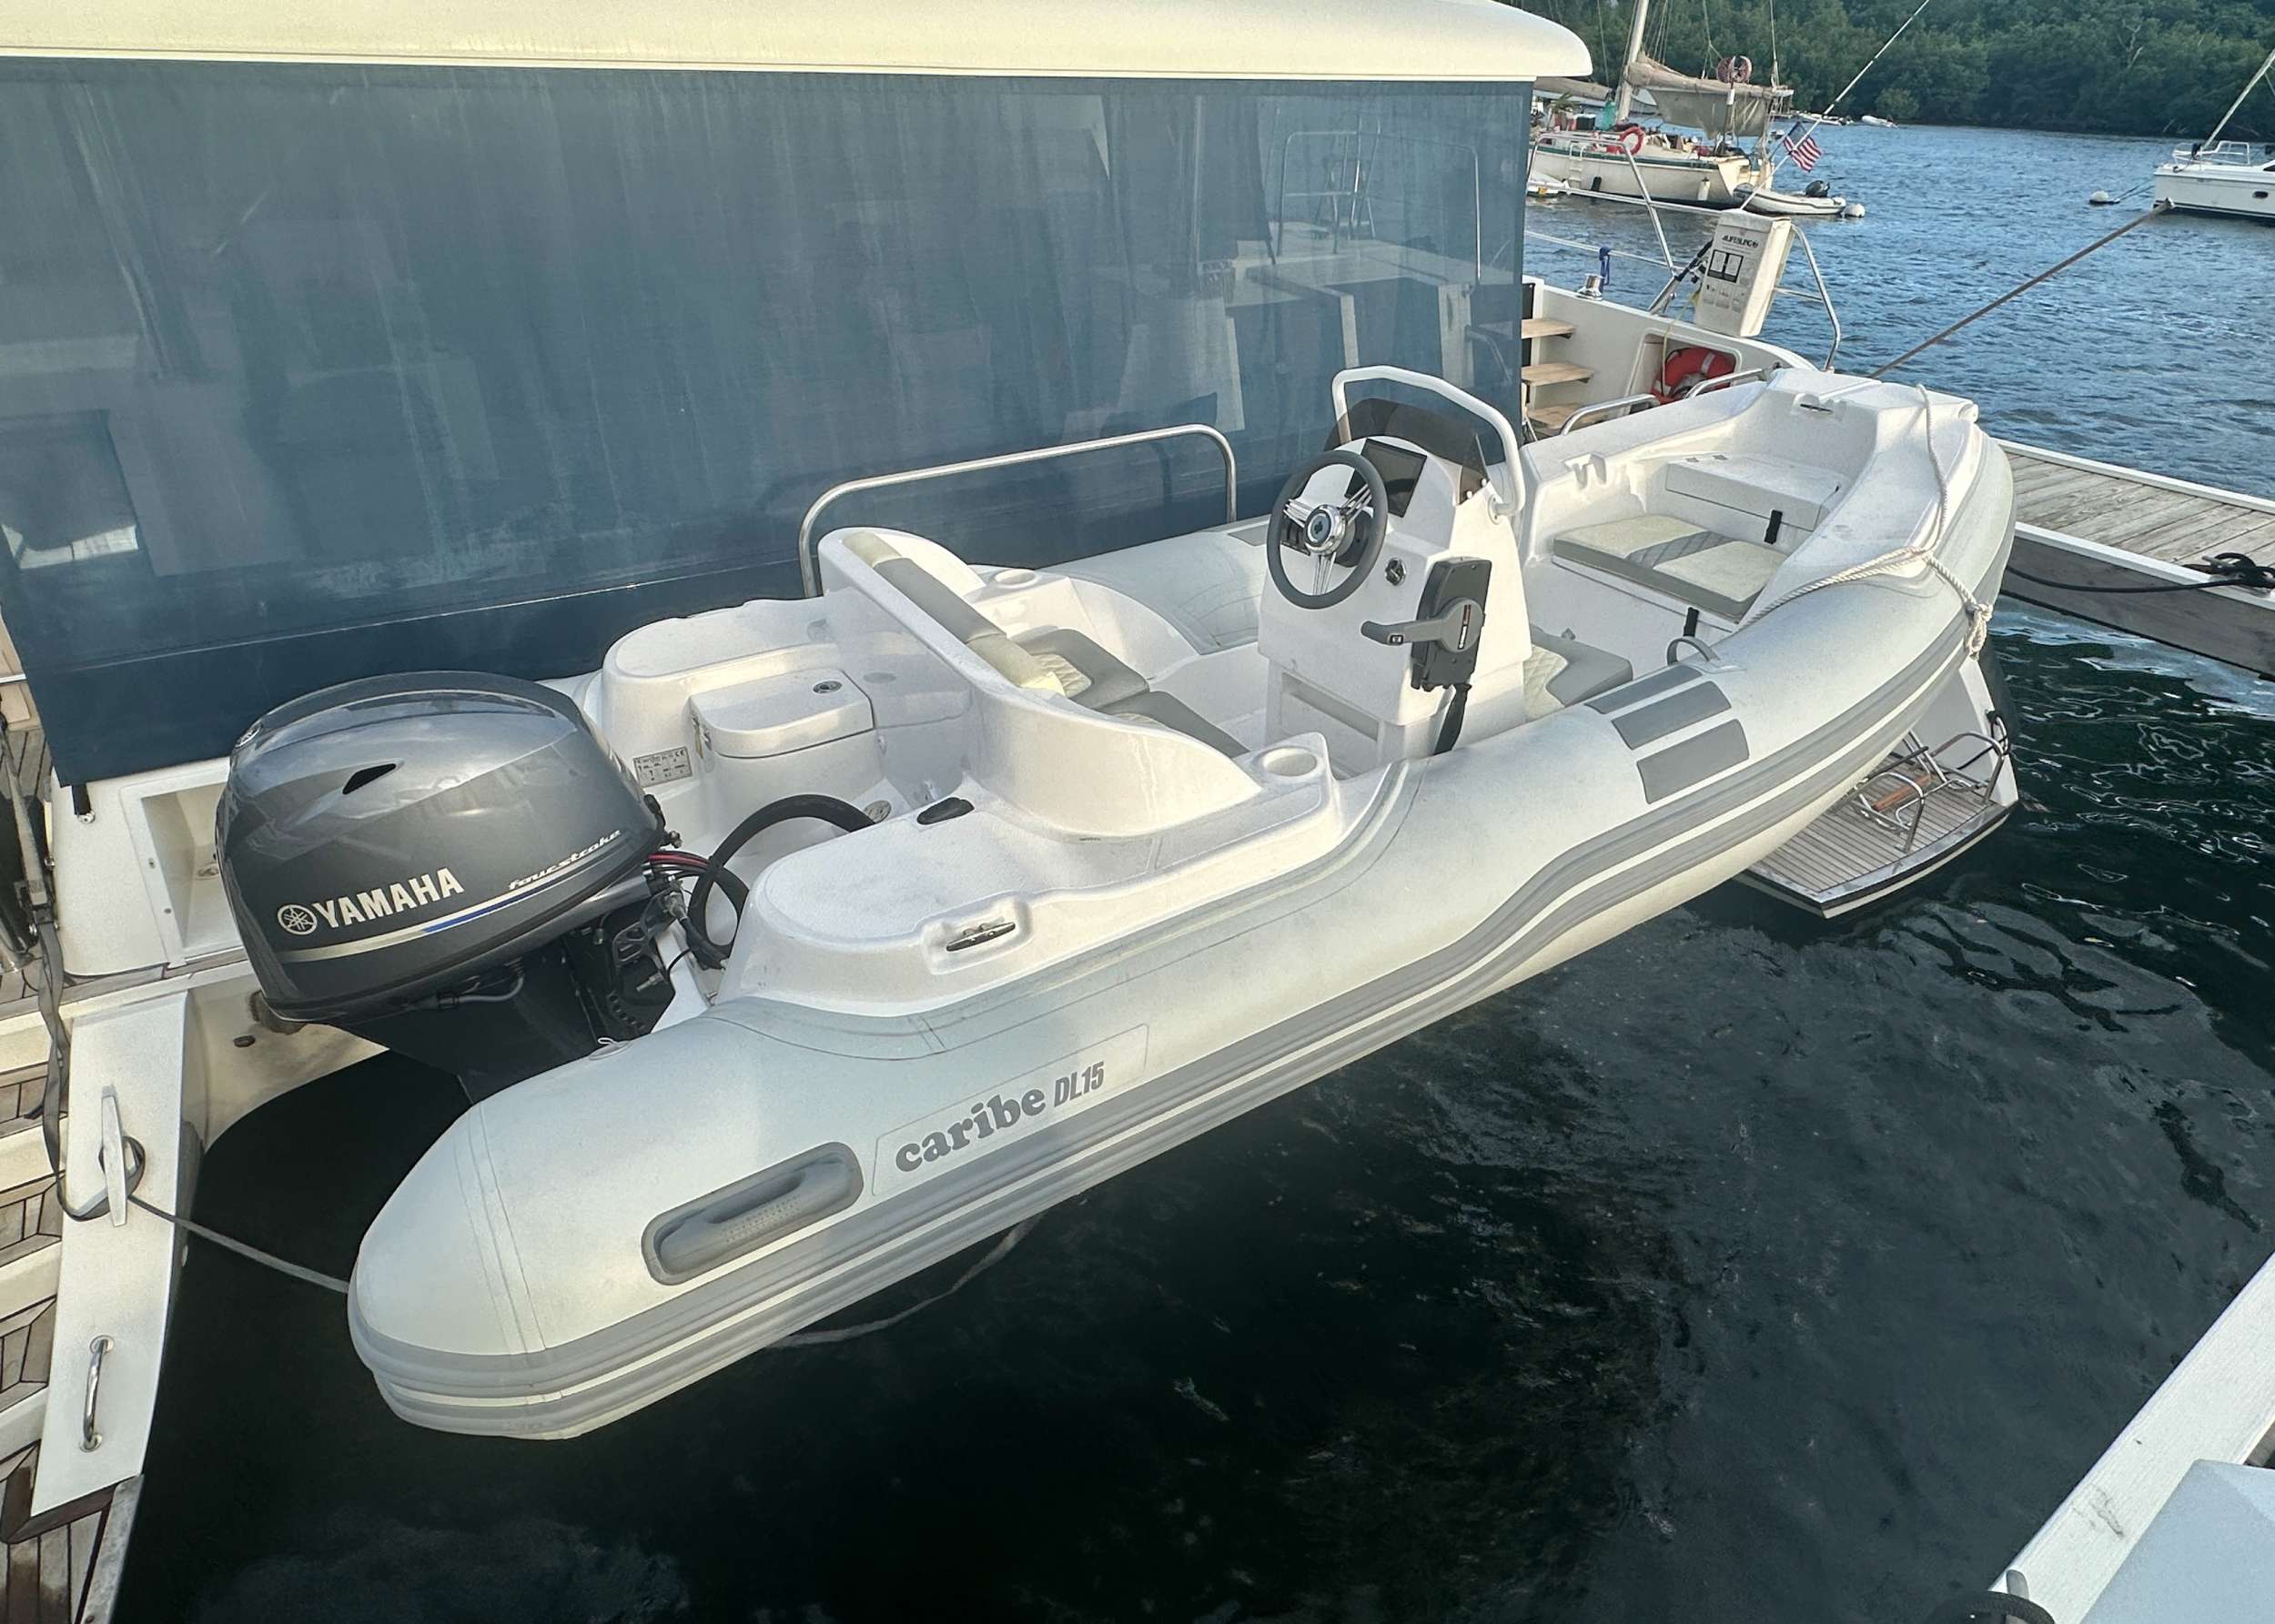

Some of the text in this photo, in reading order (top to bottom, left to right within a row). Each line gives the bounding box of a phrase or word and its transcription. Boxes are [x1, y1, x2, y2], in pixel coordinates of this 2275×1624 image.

[311, 867, 465, 928] YAMAHA
[895, 1061, 1105, 1172] caribe DL15
